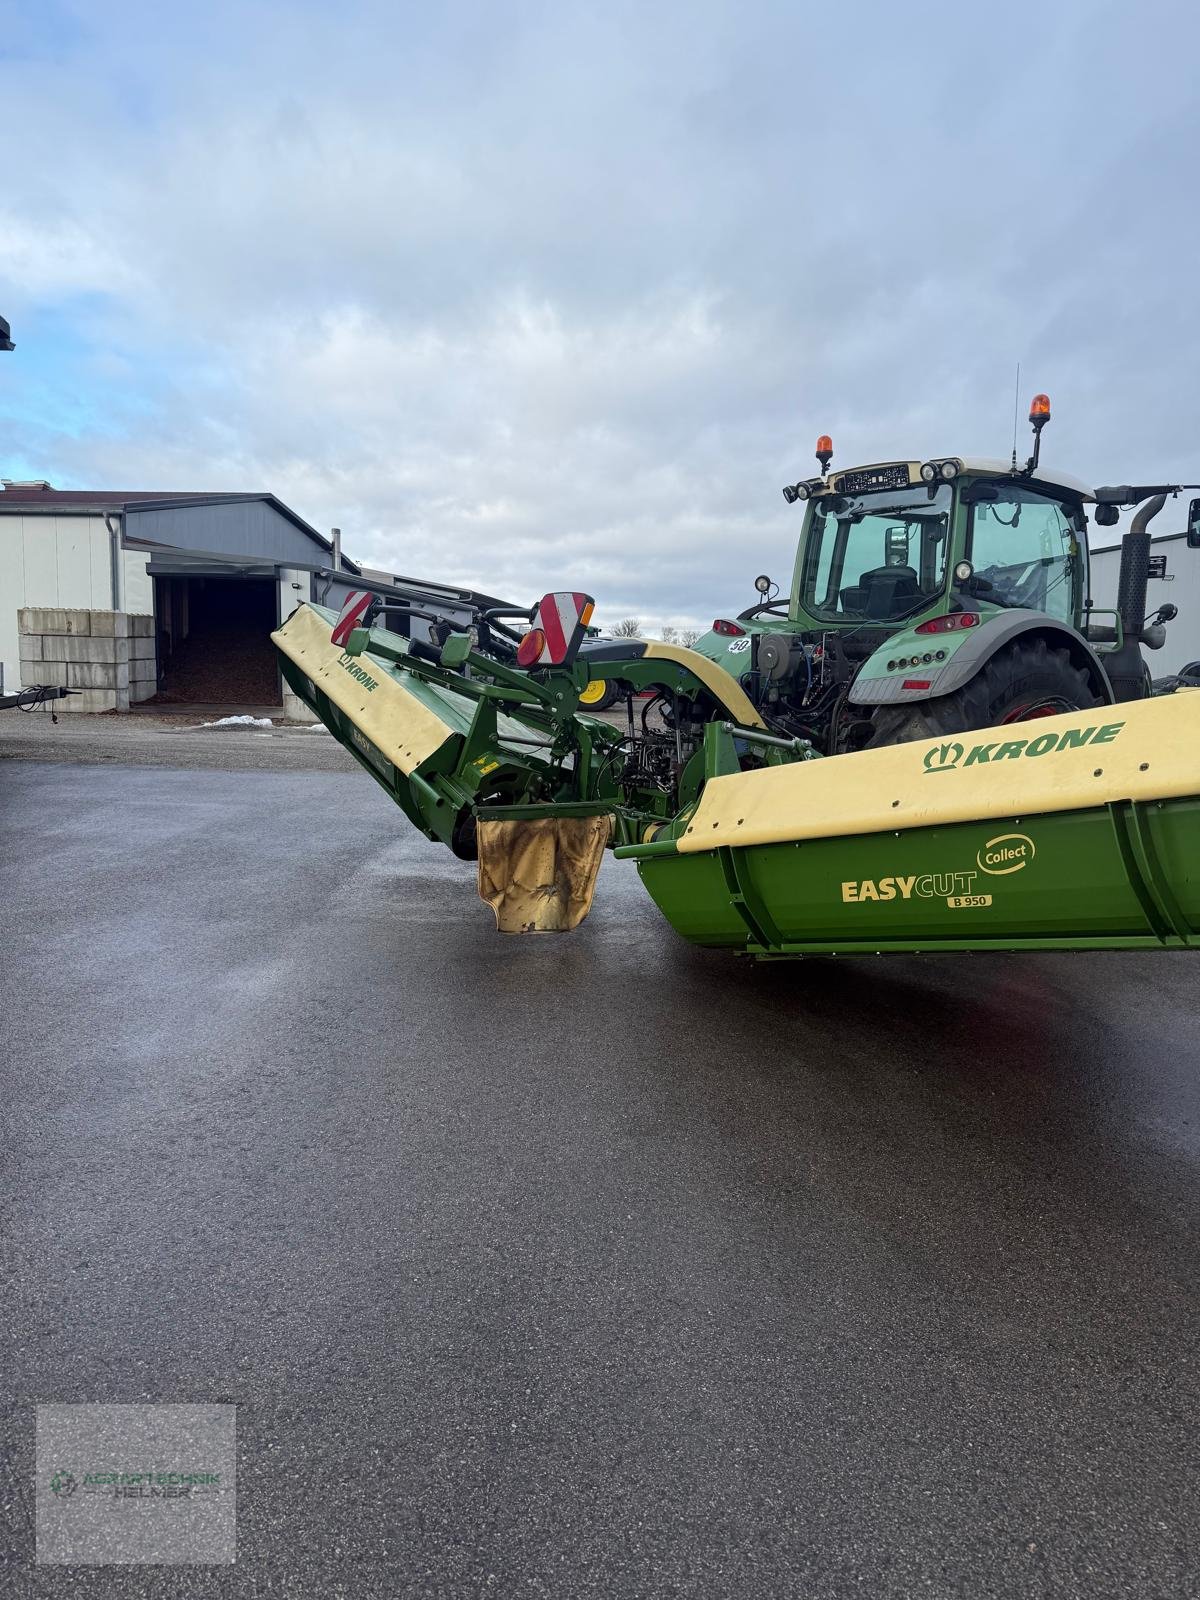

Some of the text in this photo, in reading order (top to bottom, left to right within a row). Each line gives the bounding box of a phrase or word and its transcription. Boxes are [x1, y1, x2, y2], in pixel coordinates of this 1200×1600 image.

[730, 640, 749, 651] 50
[345, 662, 379, 692] KRONE
[963, 722, 1126, 767] KRONE
[986, 845, 1026, 865] Collect
[841, 871, 977, 903] EASYCUT
[953, 896, 987, 907] B 950
